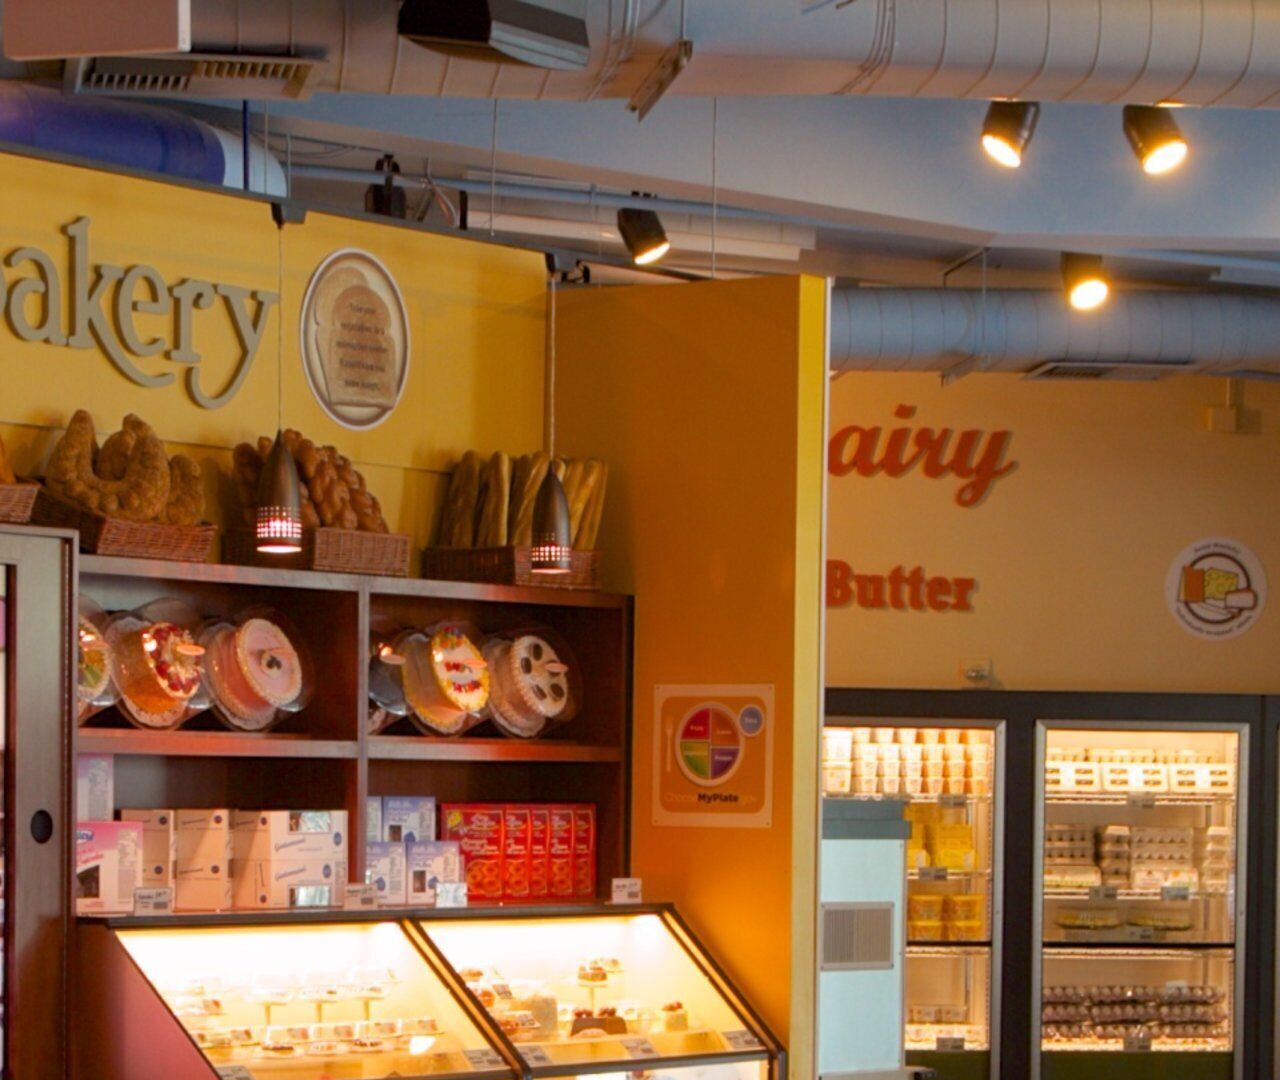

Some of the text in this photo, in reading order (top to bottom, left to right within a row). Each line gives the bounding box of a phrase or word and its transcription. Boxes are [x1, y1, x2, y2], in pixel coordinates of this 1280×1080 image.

[826, 405, 1015, 507] airy
[826, 561, 976, 611] Butter
[698, 792, 739, 804] MyPlate
